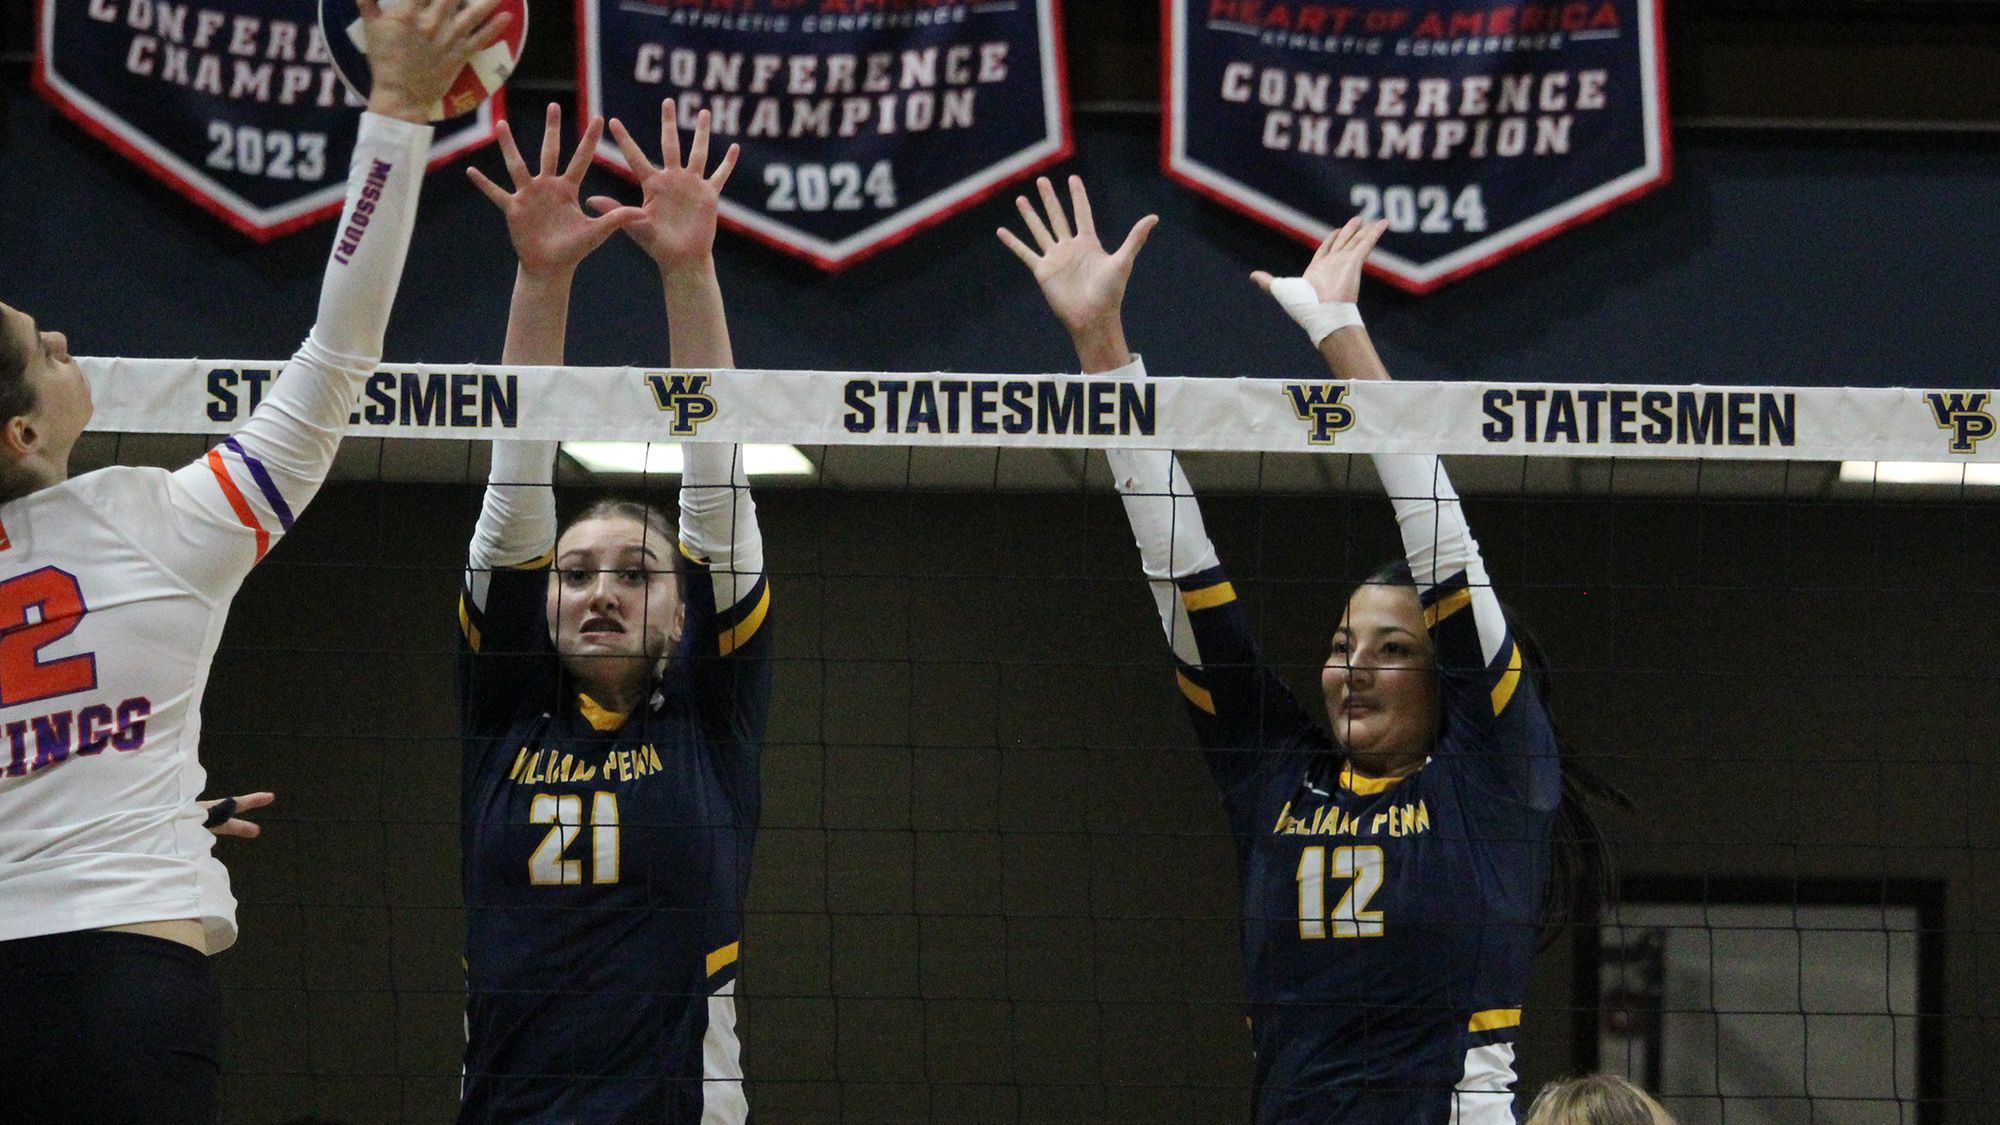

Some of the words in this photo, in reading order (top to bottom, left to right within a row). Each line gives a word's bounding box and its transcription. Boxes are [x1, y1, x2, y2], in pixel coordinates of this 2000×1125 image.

[1411, 2, 1620, 38] AMERICA
[634, 42, 1009, 94] CONFERENCE
[1221, 62, 1608, 117] CONFERENCE
[676, 88, 977, 138] CHAMPION
[1261, 110, 1574, 160] CHAMPION
[206, 119, 327, 181] 2023
[334, 158, 392, 265] MISSOURI
[762, 160, 898, 211] 2024
[1350, 183, 1488, 233] 2024
[206, 368, 518, 428] STSMEN
[843, 380, 1156, 436] STATESMEN
[1481, 389, 1796, 447] STATESMEN
[528, 791, 620, 885] 21
[1371, 799, 1431, 837] PENN
[1296, 845, 1384, 939] 12
